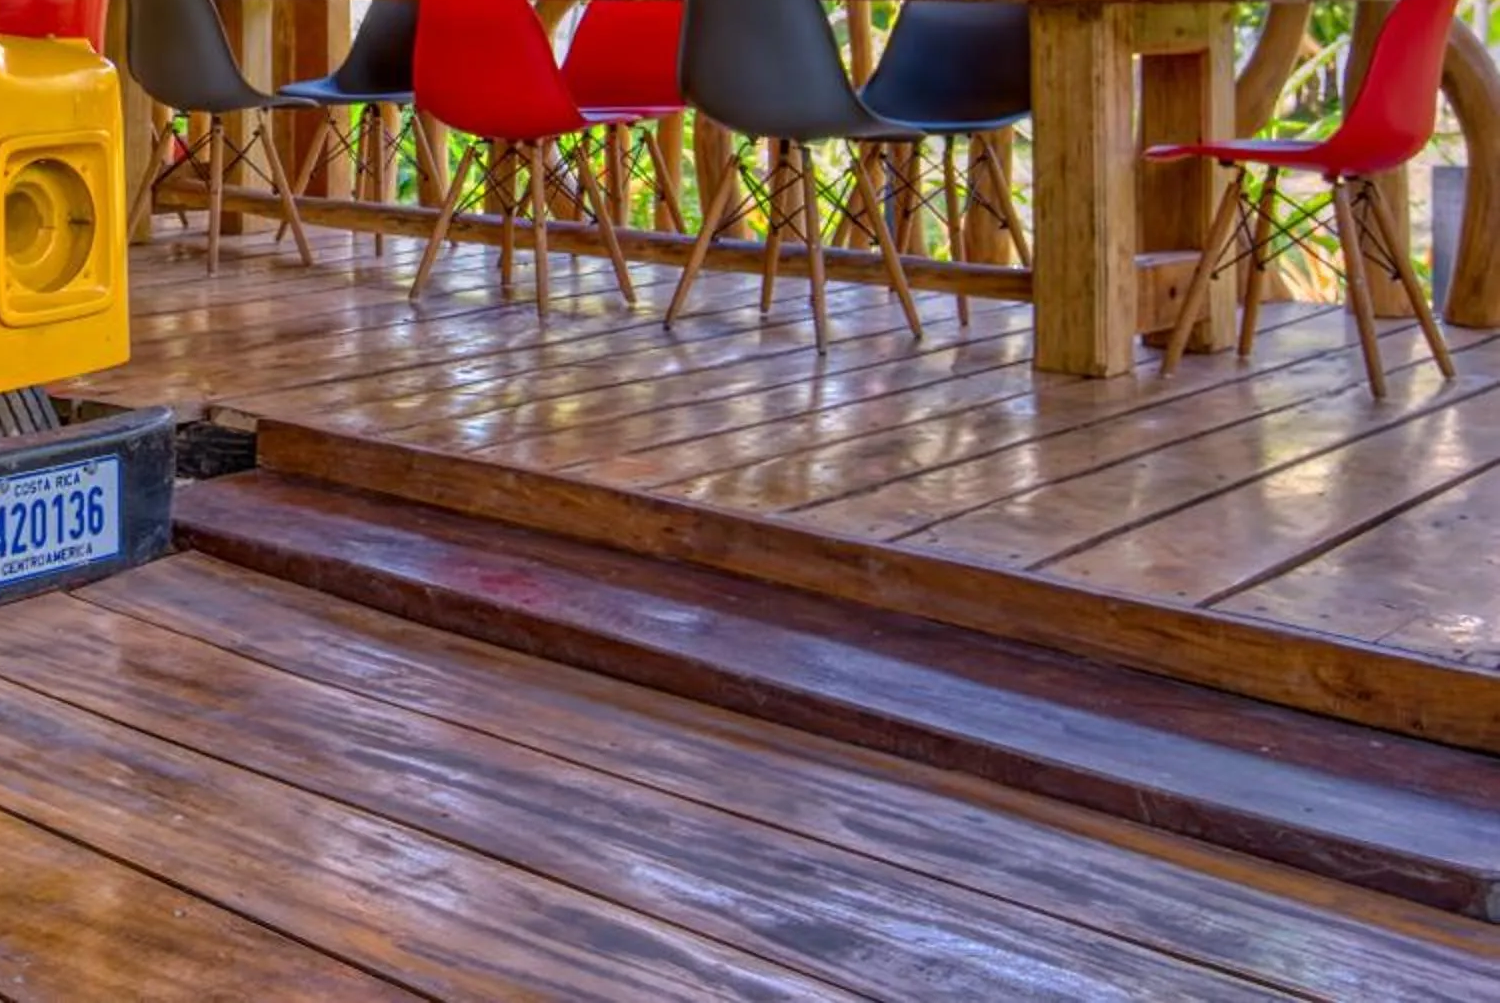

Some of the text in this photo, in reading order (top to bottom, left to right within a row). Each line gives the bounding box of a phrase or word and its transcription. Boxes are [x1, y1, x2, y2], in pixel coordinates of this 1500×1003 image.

[14, 473, 80, 497] COSTA RICA
[2, 543, 93, 576] CENTROAMERICA
